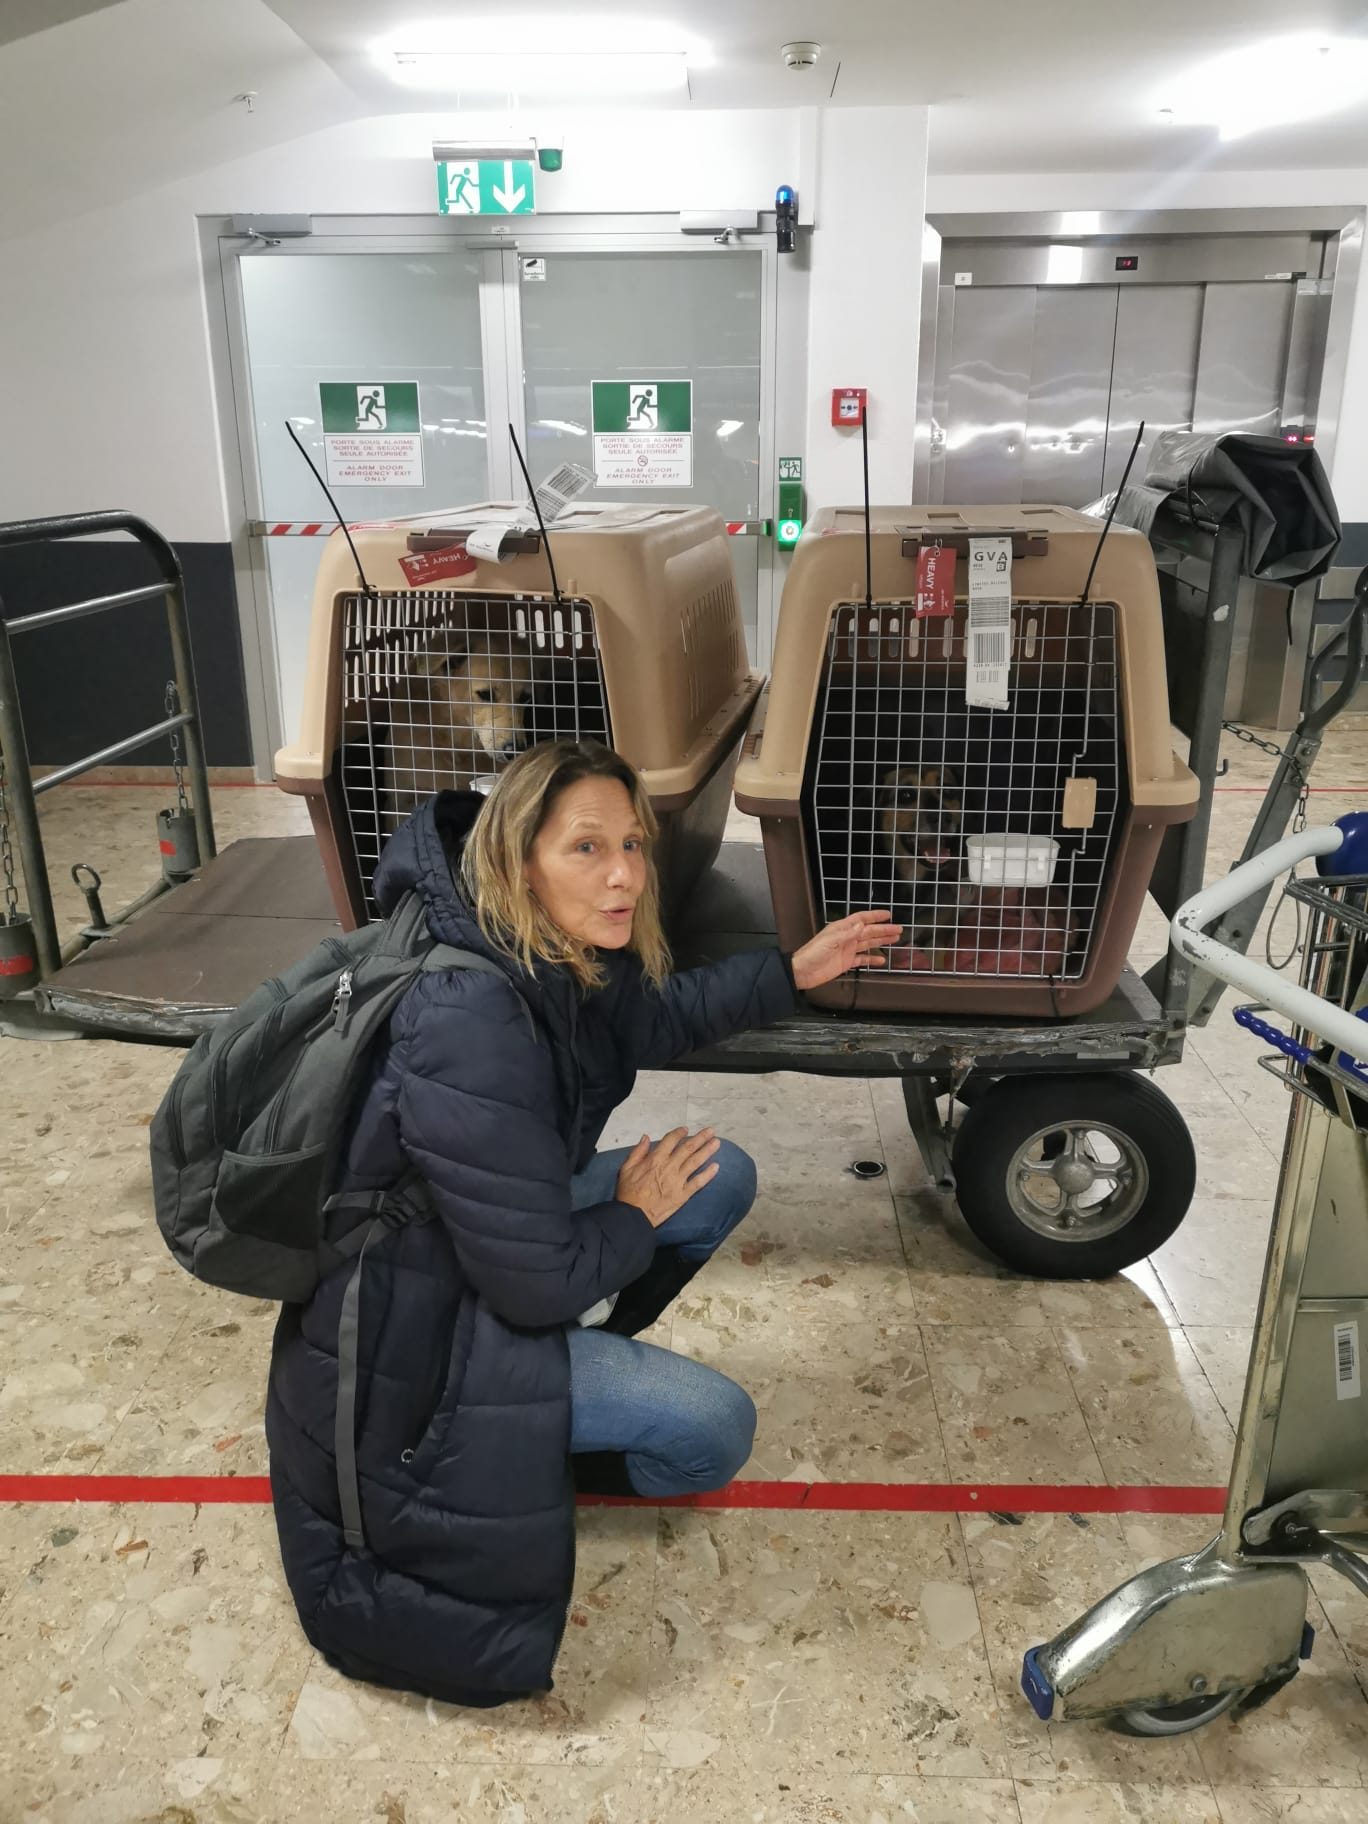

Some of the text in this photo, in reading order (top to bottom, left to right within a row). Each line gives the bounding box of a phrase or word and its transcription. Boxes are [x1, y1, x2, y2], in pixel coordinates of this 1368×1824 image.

[433, 552, 460, 566] HEAVY
[974, 552, 1008, 561] GVA
[926, 557, 936, 590] HEAVY
